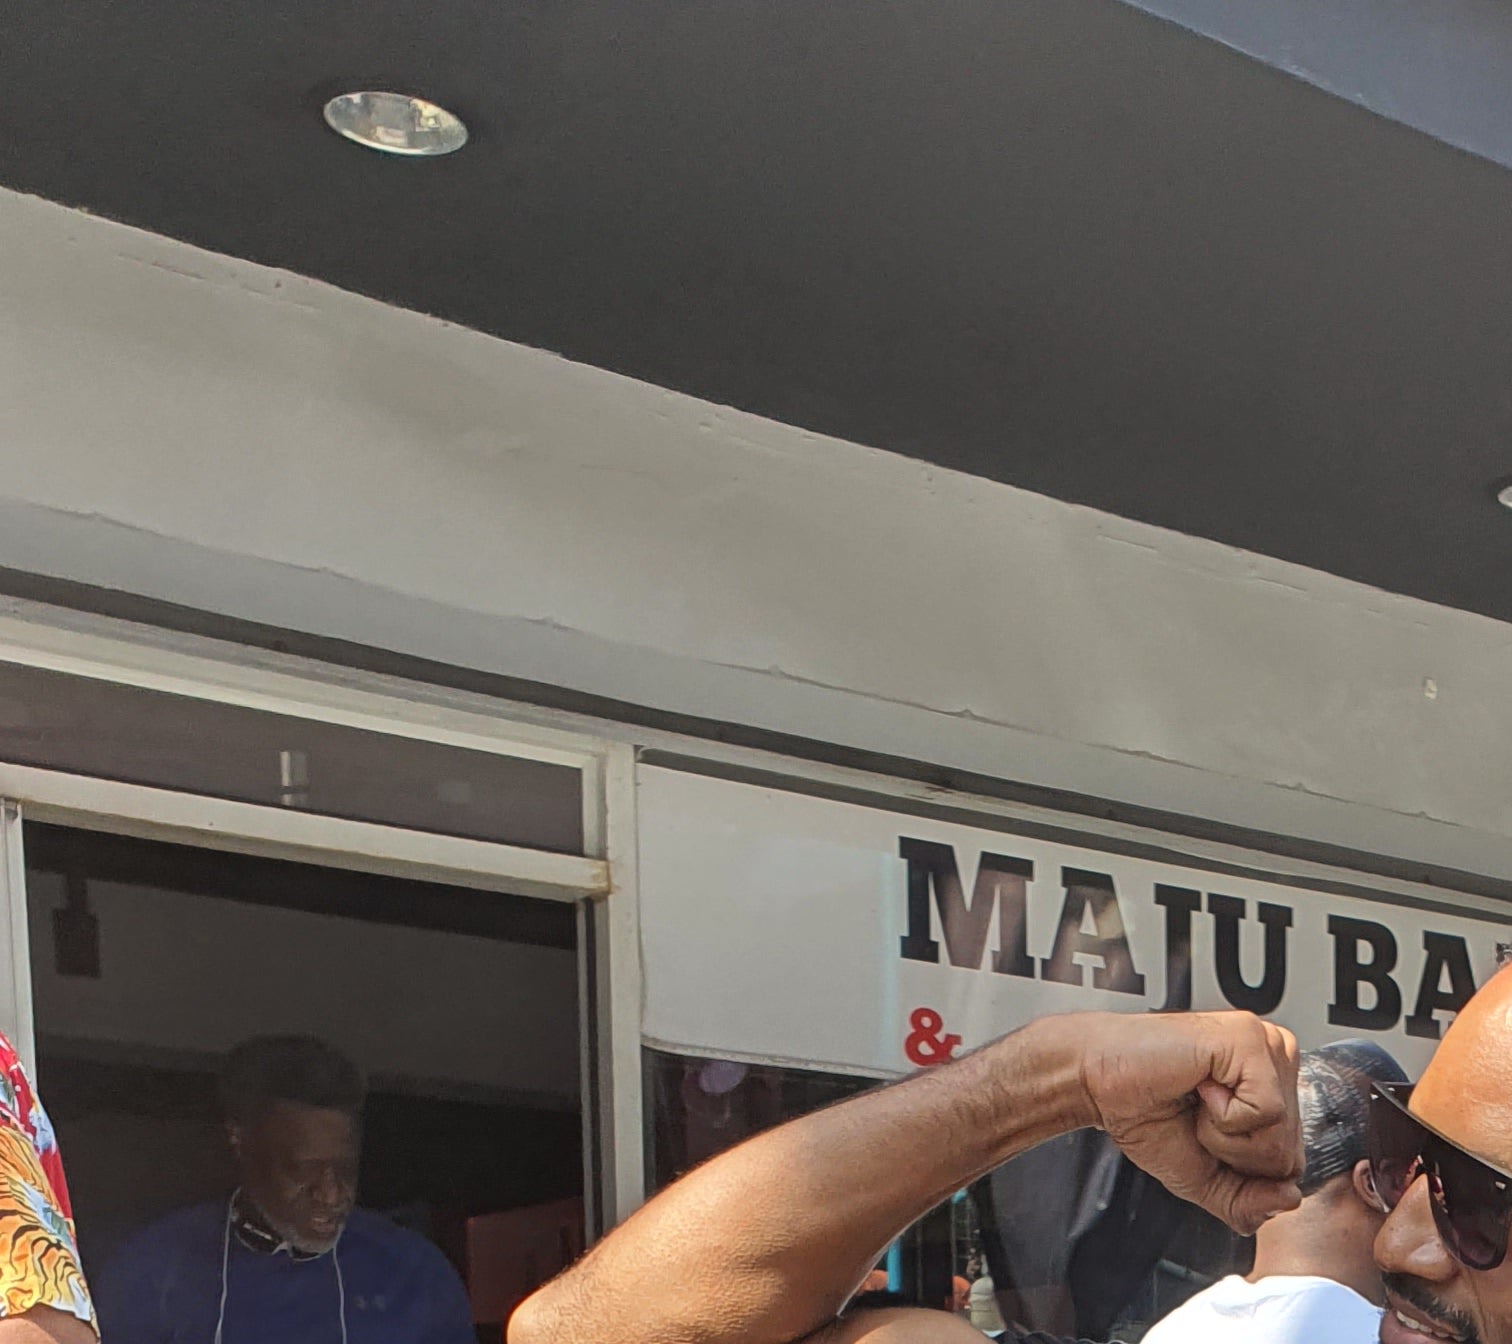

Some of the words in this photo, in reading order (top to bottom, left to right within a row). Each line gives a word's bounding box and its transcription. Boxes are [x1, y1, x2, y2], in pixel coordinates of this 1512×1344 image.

[899, 836, 1293, 1017] MAJU
[1327, 914, 1512, 1040] BA
[905, 1008, 962, 1066] &
